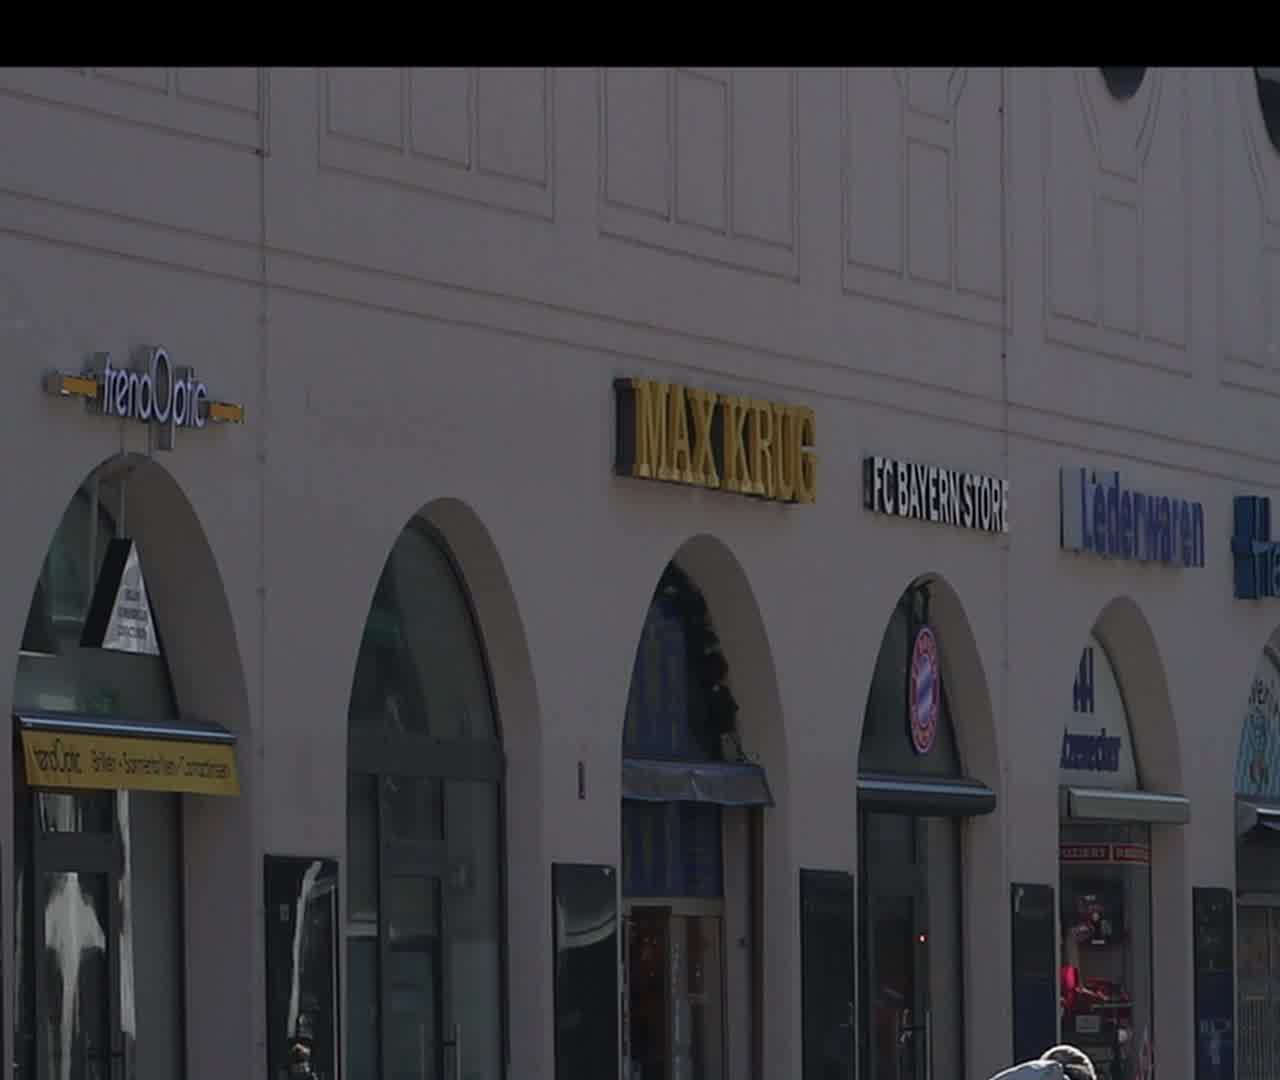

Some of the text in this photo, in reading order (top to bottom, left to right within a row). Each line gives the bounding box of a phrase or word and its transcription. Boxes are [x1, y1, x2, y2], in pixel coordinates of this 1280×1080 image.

[633, 378, 816, 504] MAX KRUG
[873, 456, 1009, 534] FC BAYERN STORE
